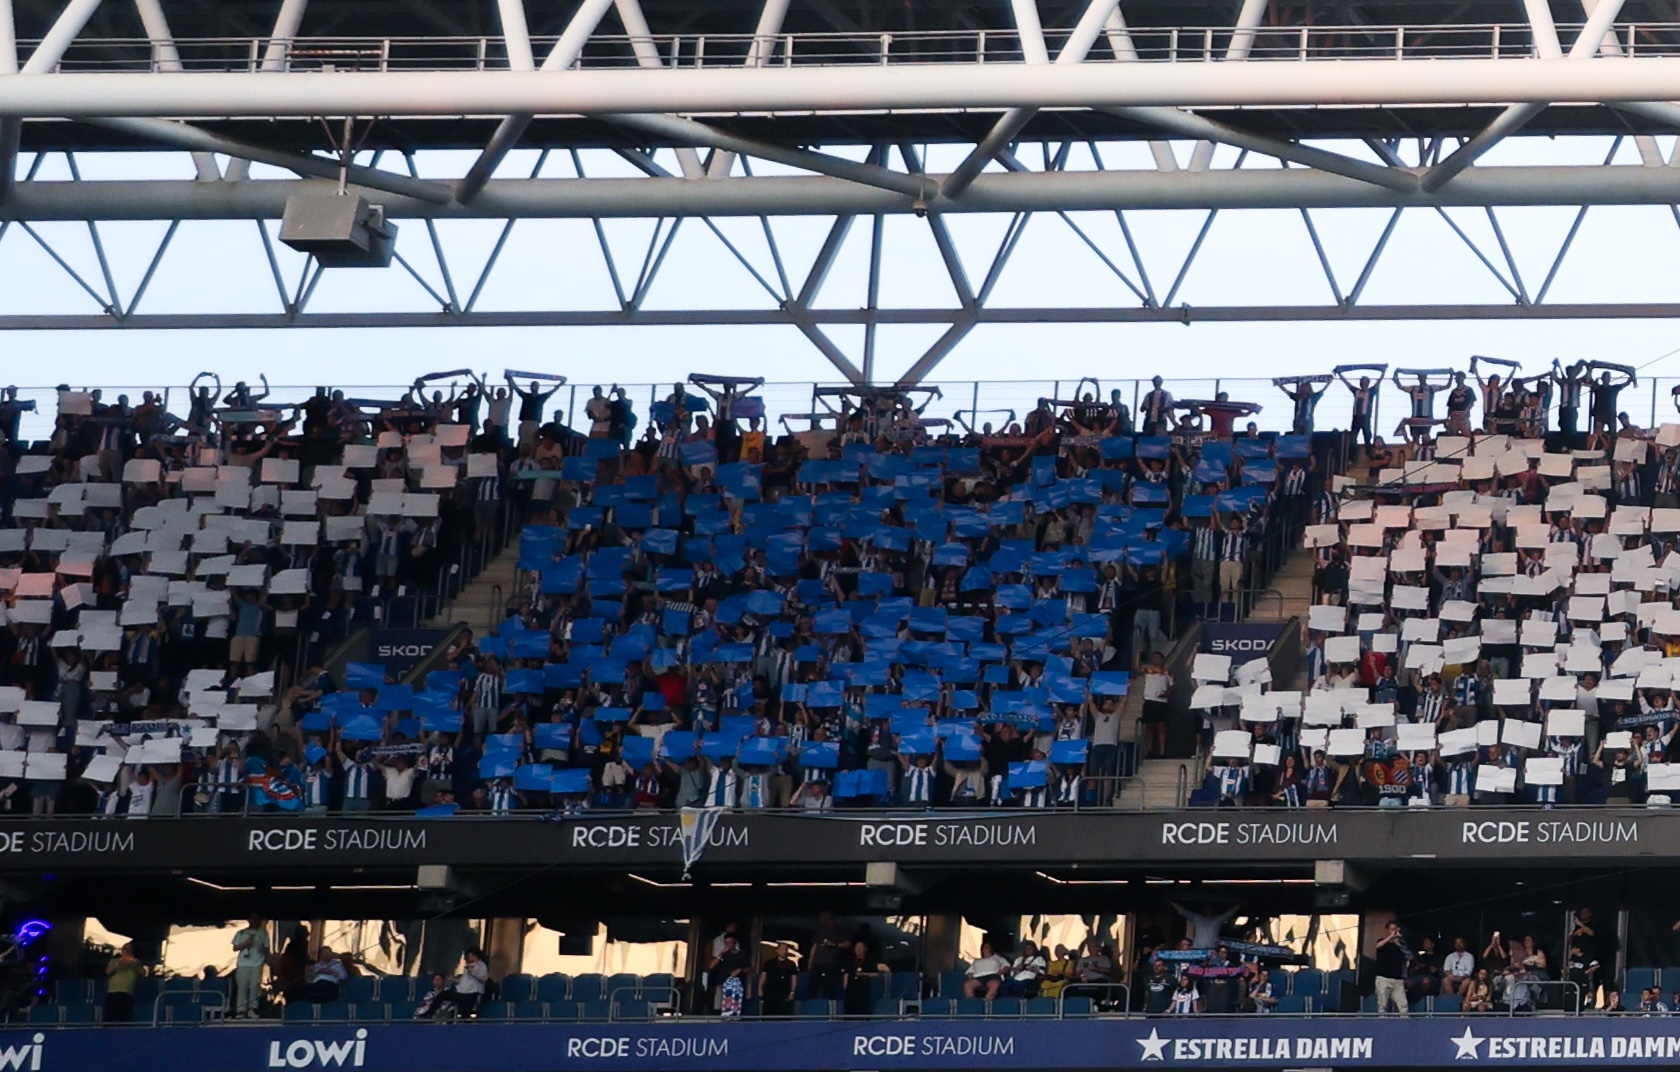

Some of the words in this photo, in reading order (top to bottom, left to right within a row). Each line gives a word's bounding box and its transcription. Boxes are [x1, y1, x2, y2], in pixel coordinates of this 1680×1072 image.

[379, 645, 433, 656] SKOD
[1211, 640, 1275, 650] SKODA
[1379, 784, 1406, 794] 1900
[0, 832, 24, 852] DE
[31, 832, 133, 852] STADIUM
[249, 830, 316, 850] RCDE
[324, 830, 425, 849] STADIUM
[573, 826, 640, 846] RCDE
[648, 825, 747, 845] STAUM
[861, 825, 927, 845] RCDE
[935, 825, 1035, 845] STADIUM
[1163, 823, 1229, 843] RCDE
[1237, 824, 1336, 843] STADIUM
[1463, 822, 1529, 842] RCDE
[1537, 822, 1637, 842] STADIUM
[568, 1038, 629, 1057] RCDE
[636, 1038, 727, 1056] STADIUM
[854, 1036, 915, 1055] RCDE
[922, 1037, 1013, 1055] STADIUM
[1175, 1039, 1290, 1059] ESTRELLA
[1296, 1038, 1372, 1058] DAMM
[1489, 1037, 1605, 1058] ESTRELLA
